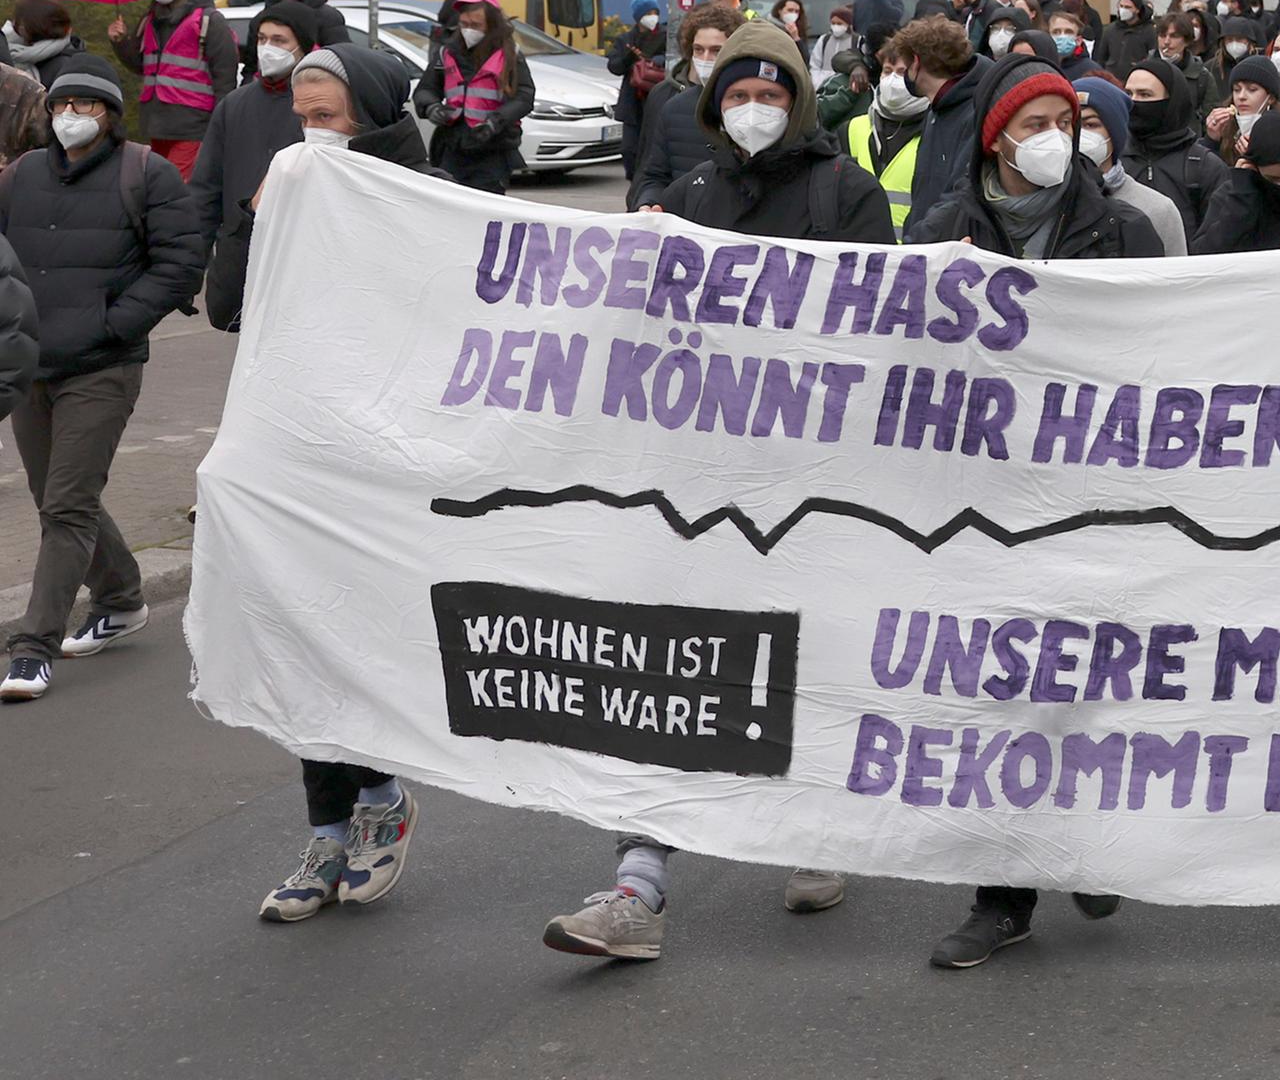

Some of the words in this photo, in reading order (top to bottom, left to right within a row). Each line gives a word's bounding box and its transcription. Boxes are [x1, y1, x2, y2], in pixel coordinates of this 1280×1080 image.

[476, 221, 814, 330] UNSEREN
[820, 251, 1039, 351] HASS
[440, 327, 588, 418] DEN
[602, 327, 865, 444] KÖNNT
[873, 363, 1017, 462] IHR
[464, 615, 648, 674] WOHNEN
[664, 637, 727, 679] IST
[870, 608, 1197, 704] UNSERE
[466, 668, 584, 718] KEINE
[600, 685, 721, 738] WARE
[847, 713, 1250, 811] BEKOMMT
